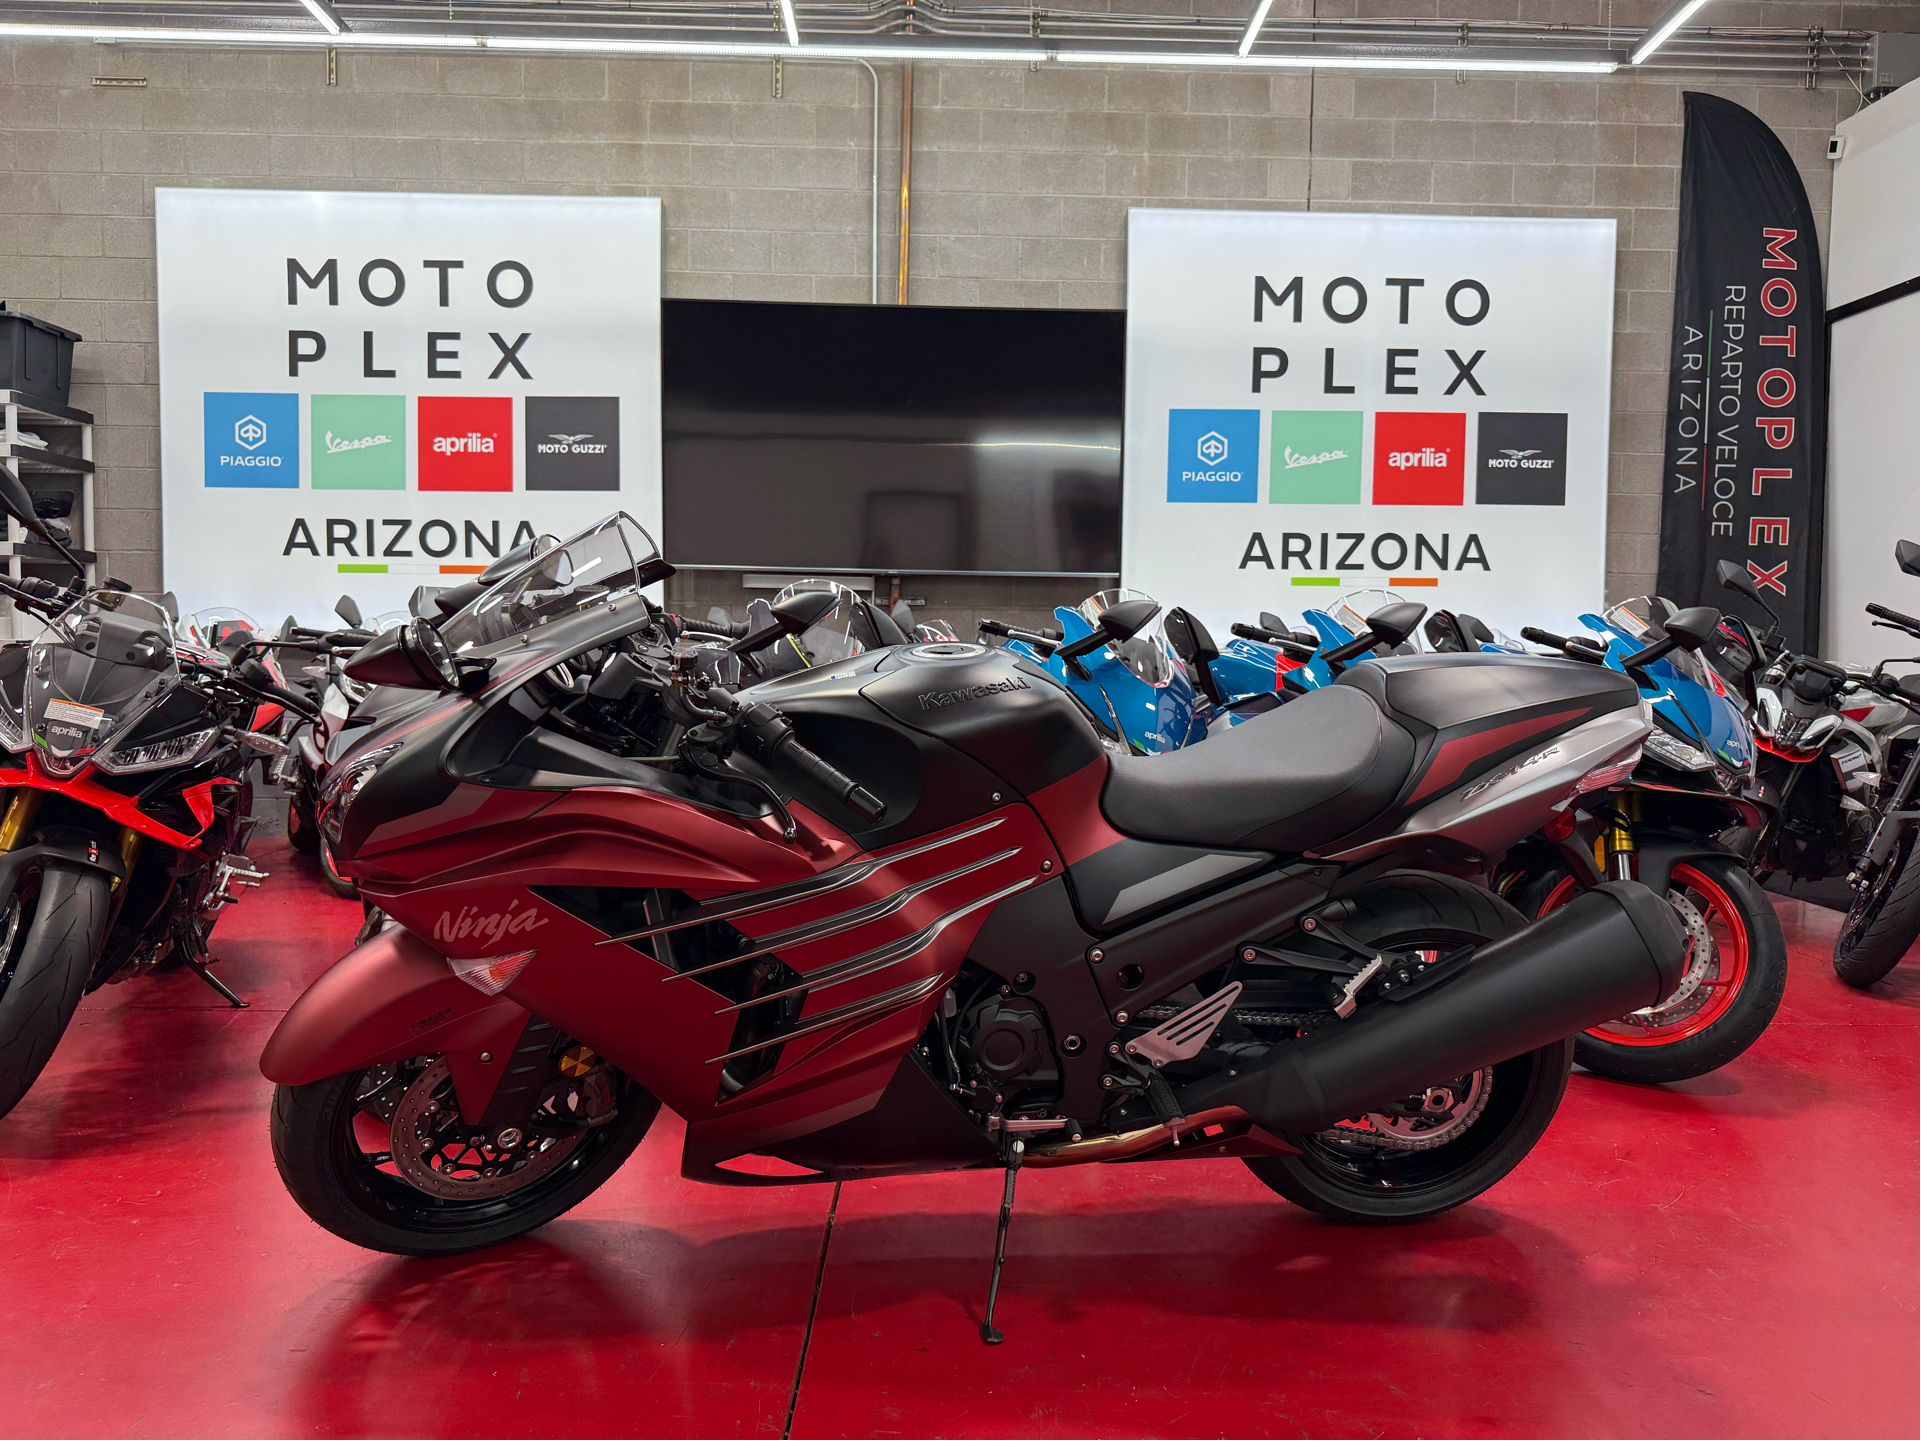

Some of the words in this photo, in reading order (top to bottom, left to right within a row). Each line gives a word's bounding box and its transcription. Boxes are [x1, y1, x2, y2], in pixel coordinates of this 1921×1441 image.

[286, 258, 534, 308] MOTO
[1253, 275, 1491, 326] MOTO
[288, 330, 534, 380] PLEX
[1717, 285, 1747, 417] REPARTO
[1251, 346, 1488, 396] PLEX
[1673, 325, 1704, 494] ARIZONA
[1746, 227, 1798, 597] MOTOPLEX
[325, 430, 392, 454] Vespa
[432, 432, 495, 456] aprilia
[537, 444, 569, 454] MOTO
[571, 444, 604, 454] GUZZI
[1284, 445, 1349, 470] Vespa
[1388, 447, 1447, 471] aprilia
[219, 455, 282, 467] PIAGGIO
[1182, 471, 1242, 482] PIAGGIO
[1488, 459, 1518, 468] MOTO
[1520, 459, 1553, 469] GUZZI
[1710, 425, 1739, 537] VELOCE
[282, 518, 536, 558] ARIZONA
[1238, 532, 1491, 571] ARIZONA
[918, 676, 1031, 711] Kawasaki
[51, 725, 83, 739] aprilia
[1144, 731, 1166, 744] aprilia
[433, 898, 550, 950] Ninja
